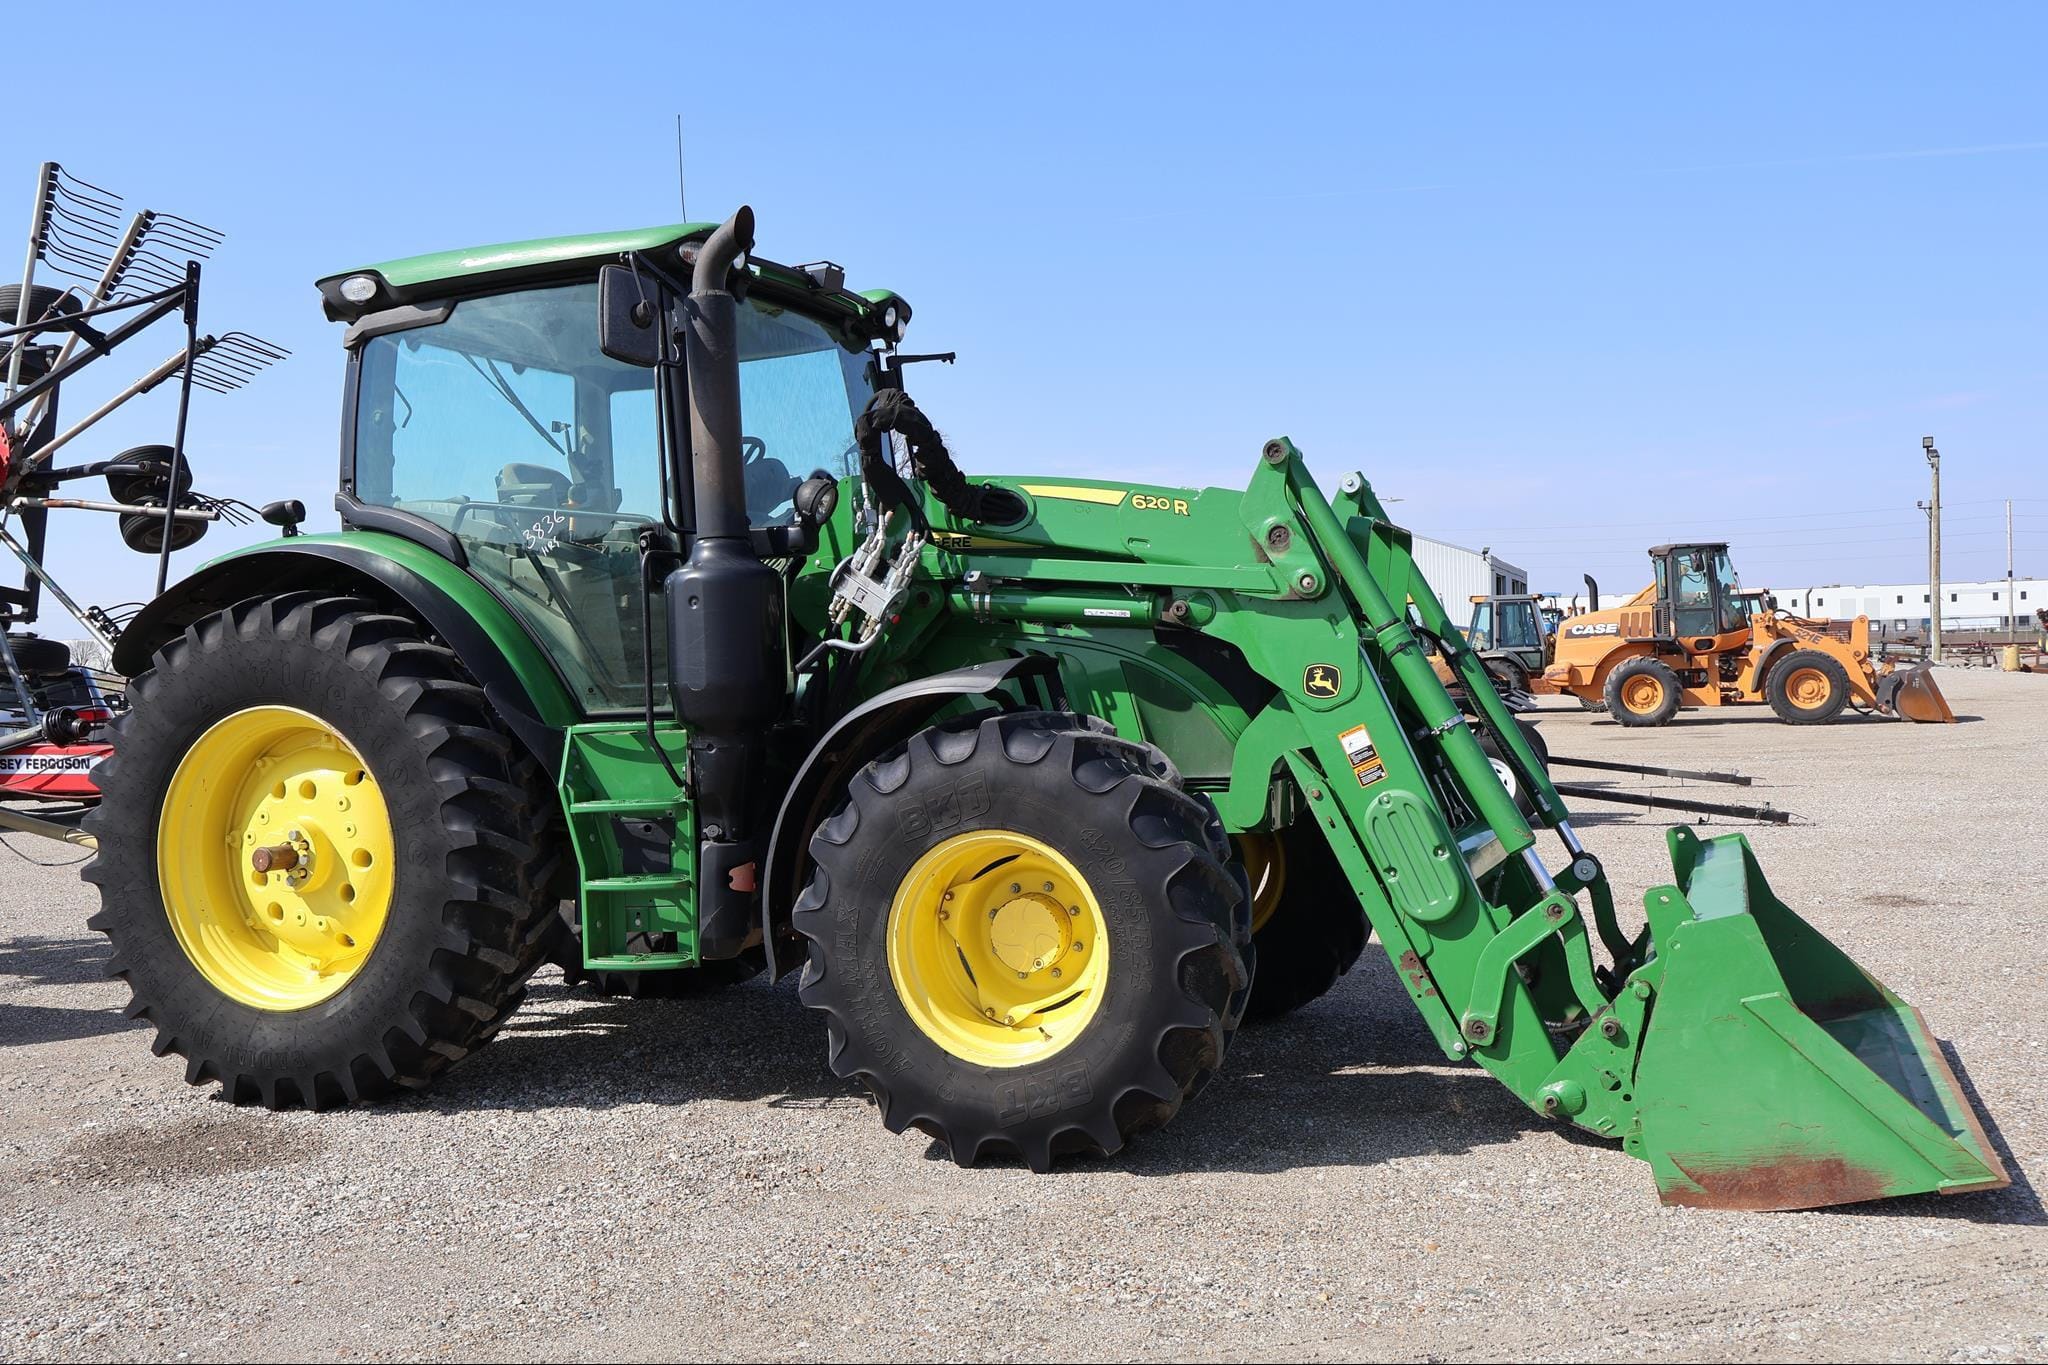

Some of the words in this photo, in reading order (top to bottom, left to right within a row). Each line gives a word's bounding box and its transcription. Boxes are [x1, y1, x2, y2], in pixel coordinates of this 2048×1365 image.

[1131, 493, 1171, 510] 620
[1173, 498, 1191, 516] R
[522, 509, 566, 549] 3836
[933, 536, 973, 547] ERE
[1571, 623, 1619, 635] CASE
[25, 758, 91, 770] FERGUSON
[896, 769, 992, 843] BKT
[993, 1058, 1095, 1129] BKT
